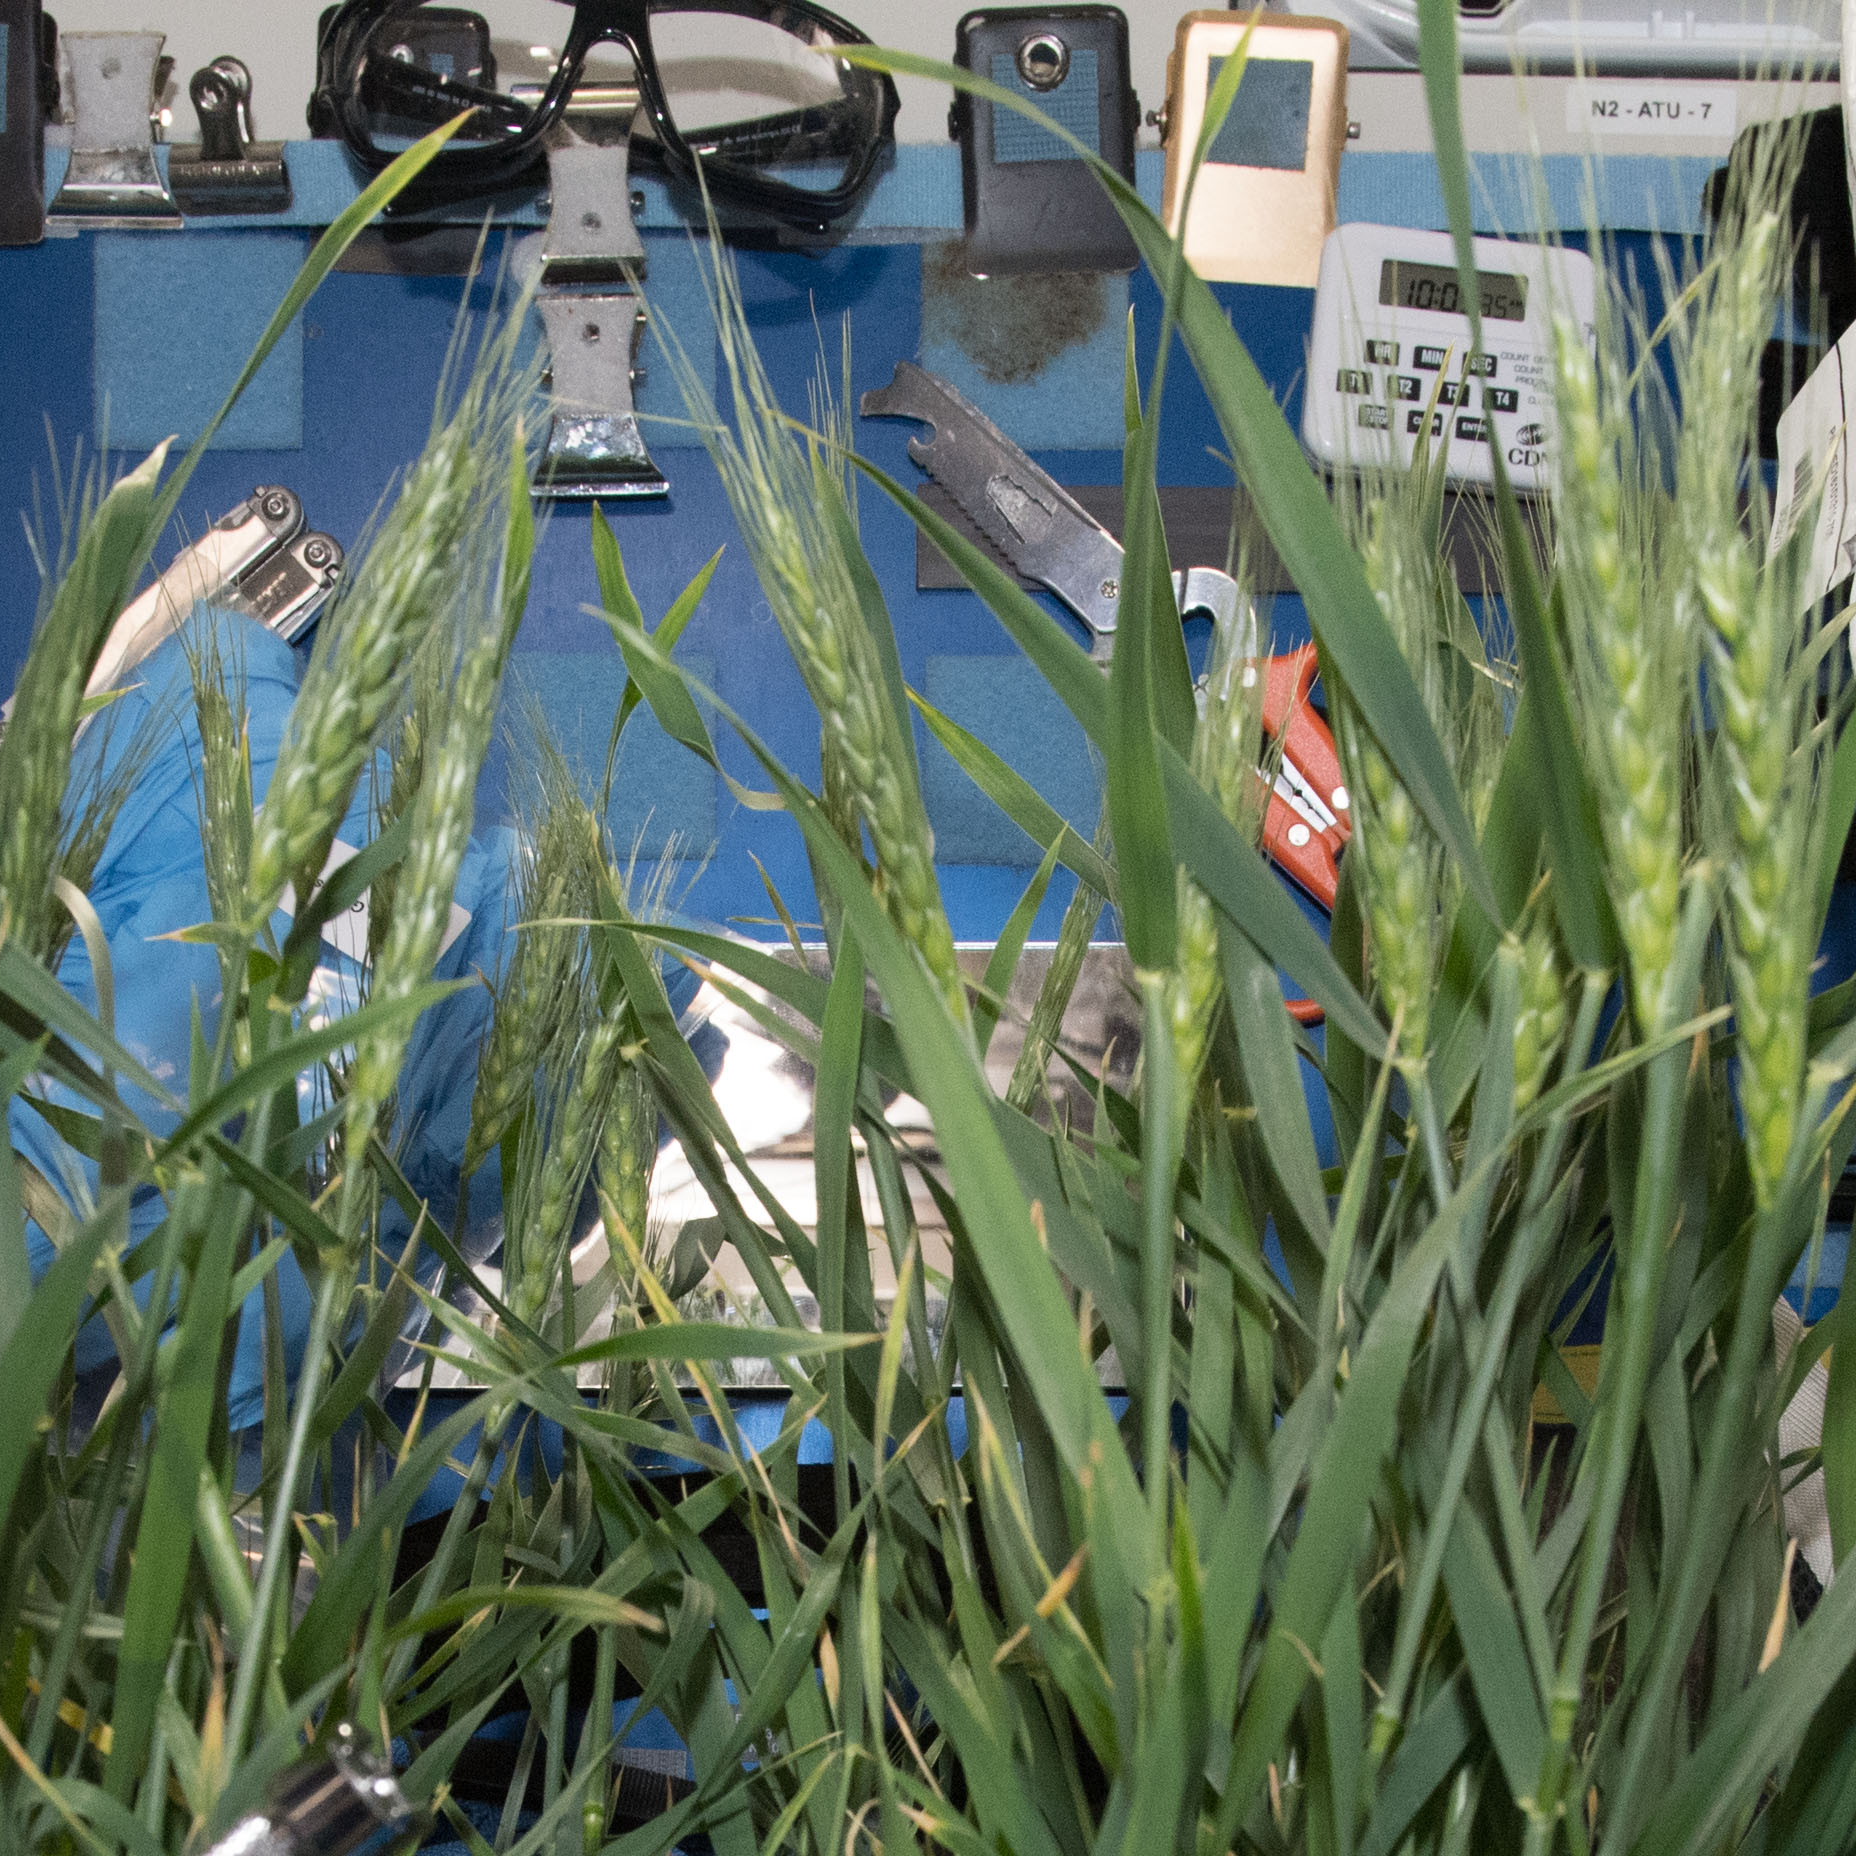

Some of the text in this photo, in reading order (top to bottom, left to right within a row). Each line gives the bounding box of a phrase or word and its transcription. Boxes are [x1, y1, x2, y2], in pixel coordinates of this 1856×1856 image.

[1593, 101, 1618, 117] N2
[1639, 102, 1680, 119] ATU
[1701, 103, 1712, 119] 7
[1407, 279, 1461, 313] 10:0
[1421, 348, 1445, 365] MIN
[1398, 379, 1413, 394] T2
[1496, 391, 1510, 406] T4
